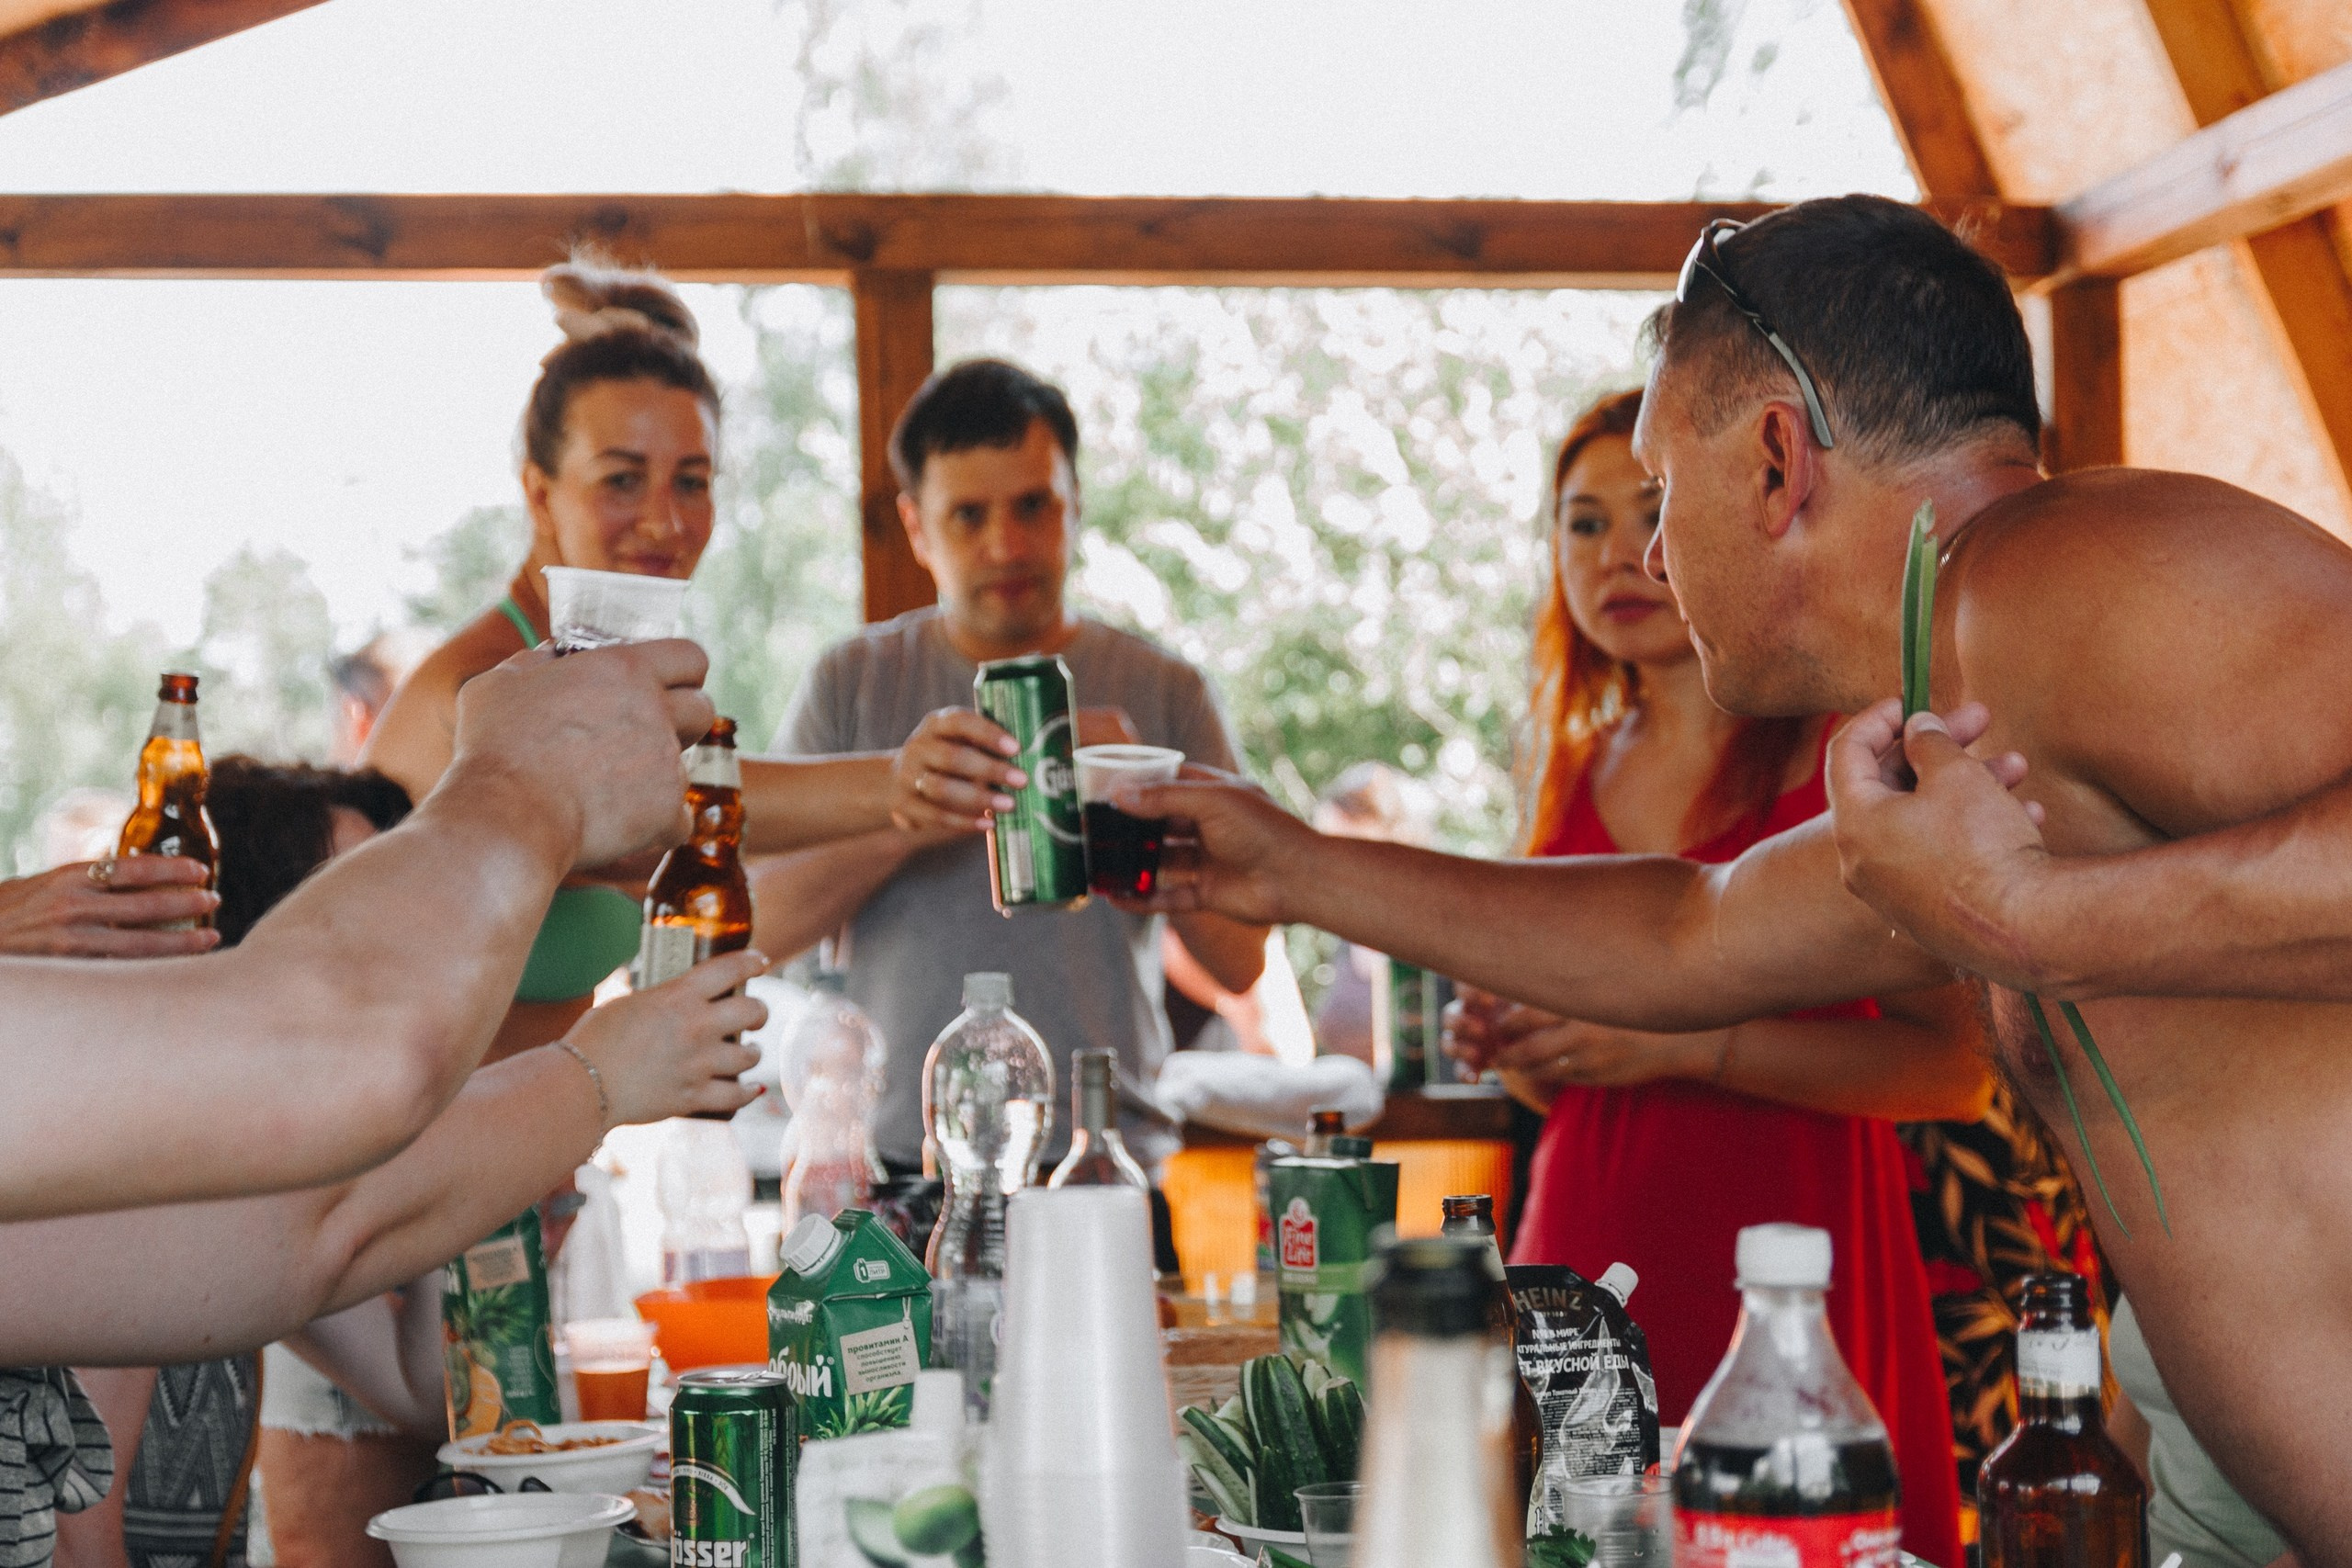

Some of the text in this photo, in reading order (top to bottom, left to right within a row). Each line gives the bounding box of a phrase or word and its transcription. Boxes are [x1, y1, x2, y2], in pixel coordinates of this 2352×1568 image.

[1512, 1287, 1582, 1313] HEINZ
[847, 1334, 909, 1355] провитамин А
[856, 1346, 902, 1359] способствует
[1517, 1341, 1567, 1354] АТУРАЛЬНЫЕ
[1536, 1352, 1600, 1374] ВКУСНОЙ
[1603, 1355, 1630, 1370] ЕДЫ
[865, 1371, 901, 1382] организма
[673, 1529, 748, 1568] össer
